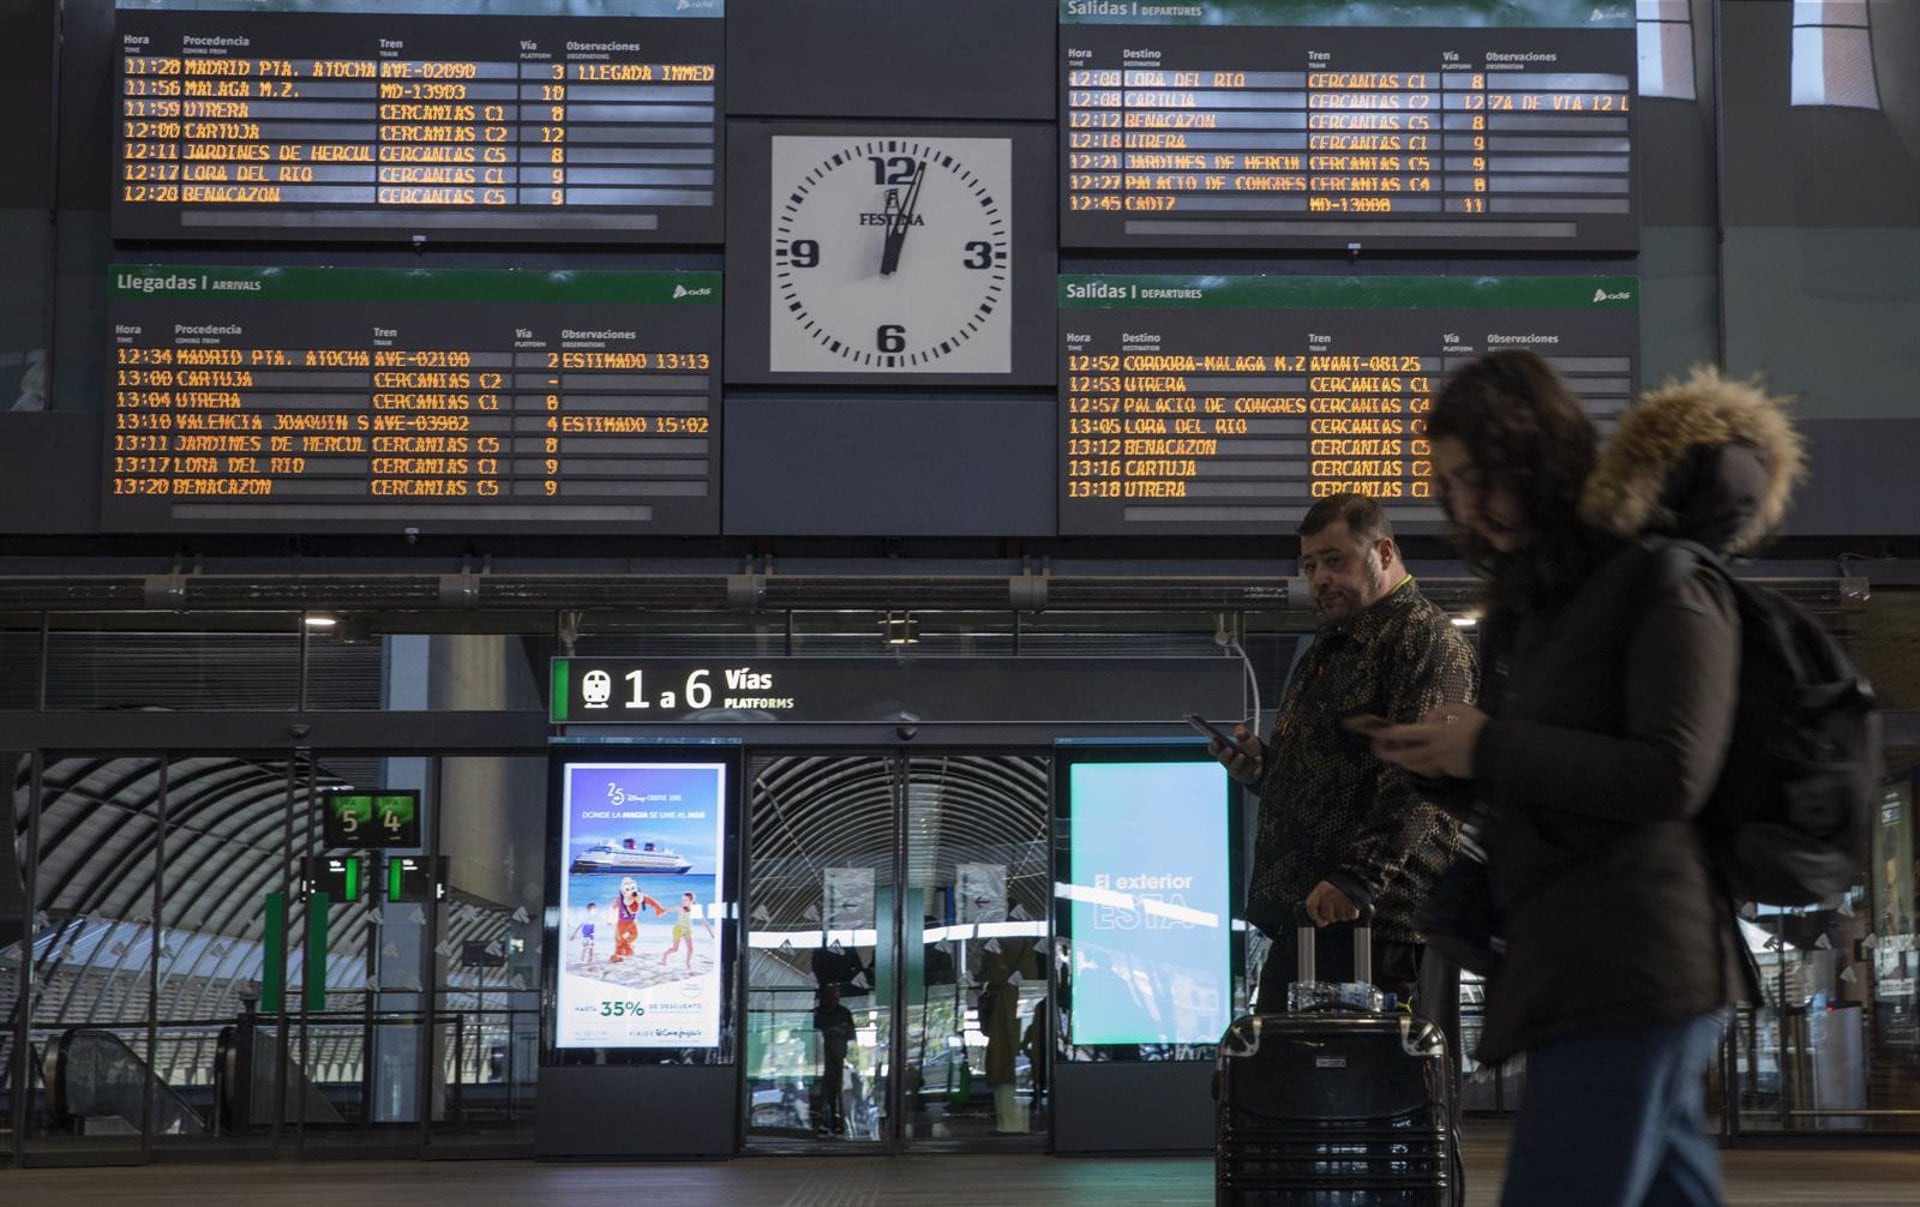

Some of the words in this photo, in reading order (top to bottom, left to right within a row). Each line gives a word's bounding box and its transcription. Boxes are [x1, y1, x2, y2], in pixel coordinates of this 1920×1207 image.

[1069, 0, 1128, 15] Salidas
[1140, 7, 1204, 18] DEPARTURES
[184, 36, 249, 46] Procedencia
[520, 40, 537, 50] Vía
[566, 42, 640, 51] Observaciones
[1069, 49, 1092, 57] Hora
[1123, 49, 1161, 58] Destino
[1486, 52, 1556, 61] Observaciones
[128, 59, 182, 75] 11:28
[184, 60, 250, 74] MADRID
[313, 62, 375, 77] ATOCHA
[553, 64, 564, 81] 3
[580, 65, 651, 80] LLEGADA
[664, 66, 714, 80] INMED
[128, 79, 181, 96] 11:56
[184, 81, 249, 96] MALAGA
[127, 100, 182, 118] 11:59
[184, 102, 248, 119] UTRERA
[380, 104, 474, 121] CERCANIAS
[1069, 112, 1120, 129] 12:12
[127, 122, 181, 139] 12:00
[184, 123, 259, 139] CARTUJA
[381, 125, 475, 142] CERCANIAS
[485, 125, 508, 143] C2
[543, 127, 565, 144] 12
[1071, 134, 1123, 149] 12:18
[126, 143, 177, 160] 12:11
[183, 144, 269, 160] JARDINES
[280, 145, 301, 162] DE
[312, 146, 373, 162] HERCUL
[379, 146, 474, 163] CERCANIAS
[483, 146, 506, 163] C5
[552, 147, 563, 163] 8
[126, 164, 179, 181] 12:17
[183, 165, 228, 182] LORA
[236, 166, 268, 182] DEL
[280, 166, 312, 182] RIO
[381, 168, 475, 185] CERCANIAS
[869, 157, 916, 185] 12
[125, 186, 179, 202] 12:20
[182, 188, 279, 202] BENACAZON
[380, 190, 474, 206] CERCANIAS
[484, 189, 506, 206] C5
[552, 191, 563, 207] 9
[1072, 195, 1122, 210] 12:45
[860, 214, 924, 225] FESTNA
[791, 240, 819, 267] 9
[963, 242, 992, 269] 3
[118, 275, 196, 292] Llegadas
[212, 281, 261, 290] ARRIVALS
[1067, 283, 1126, 298] Salidas
[1142, 287, 1204, 298] DEPARTURES
[116, 325, 141, 334] Hora
[175, 325, 242, 334] Procedencia
[374, 328, 397, 336] Tren
[562, 330, 636, 339] Observaciones
[877, 325, 905, 353] 6
[1067, 333, 1090, 342] Hora
[1123, 333, 1160, 342] Destino
[1309, 334, 1331, 342] Tren
[1444, 333, 1459, 343] Vía
[1488, 334, 1559, 343] Observaciones
[119, 348, 173, 364] 12:34
[177, 349, 242, 364] MADRID
[252, 350, 290, 365] PTA.
[306, 350, 370, 366] ATOCHA
[549, 352, 559, 369] 2
[563, 353, 646, 368] ESTIMADO
[657, 353, 709, 369] 13:13
[1070, 355, 1119, 372] 12:52
[1123, 356, 1266, 371] CORDOBA-MALAGA
[176, 372, 253, 386] CARTUJA
[375, 373, 469, 388] CERCANIAS
[479, 373, 502, 390] C2
[1069, 376, 1122, 392] 12:53
[1123, 377, 1186, 392] UTRERA
[1310, 377, 1401, 392] CERCANIAS
[1410, 377, 1430, 394] C1
[175, 393, 240, 408] UTRERA
[372, 394, 469, 409] CERCANIAS
[477, 394, 498, 411] C1
[1070, 397, 1121, 413] 12:57
[1124, 398, 1195, 413] PALACIO
[1205, 398, 1226, 412] DE
[1235, 398, 1306, 412] CONGRES
[1310, 398, 1401, 413] CERCANIAS
[118, 414, 172, 429] 13:10
[176, 414, 263, 430] VALENCIA
[275, 415, 349, 430] JOAQUIN
[561, 416, 647, 432] ESTIMADO
[1070, 418, 1121, 434] 13:05
[1125, 418, 1167, 434] LORA
[1174, 418, 1206, 435] DEL
[1215, 418, 1247, 433] RIO
[1311, 419, 1402, 434] CERCANIAS
[116, 434, 167, 451] 13:11
[175, 435, 261, 451] JARDINES
[272, 436, 292, 452] DE
[303, 436, 366, 451] HERCUL
[373, 436, 468, 452] CERCANIAS
[476, 436, 500, 452] C5
[1071, 439, 1121, 456] 13:12
[1125, 439, 1215, 455] BENACAZON
[1312, 439, 1401, 455] CERCANIAS
[117, 456, 171, 473] 13:17
[174, 456, 217, 472] LORA
[227, 457, 260, 473] DEL
[271, 457, 305, 473] RIO
[372, 458, 467, 474] CERCANIAS
[477, 458, 497, 474] C1
[546, 459, 557, 472] 9
[1070, 460, 1121, 476] 13:16
[1126, 460, 1196, 477] CARTUJA
[1313, 460, 1402, 476] CERCANIAS
[1411, 460, 1432, 478] C2
[115, 478, 169, 494] 13:20
[173, 479, 272, 494] BENACAZON
[372, 480, 466, 495] CERCANIAS
[476, 480, 499, 495] C5
[545, 480, 556, 495] 9
[1070, 480, 1122, 496] 13:18
[1124, 480, 1185, 497] UTRERA
[1411, 481, 1430, 497] C1
[625, 670, 649, 708] 1
[660, 692, 675, 708] a
[686, 670, 712, 708] 6
[725, 668, 772, 689] Vías
[725, 698, 794, 708] PLATFORMS
[343, 811, 357, 832] 5
[384, 811, 400, 831] 4
[1116, 874, 1193, 889] exterior
[601, 1002, 644, 1016] 35%
